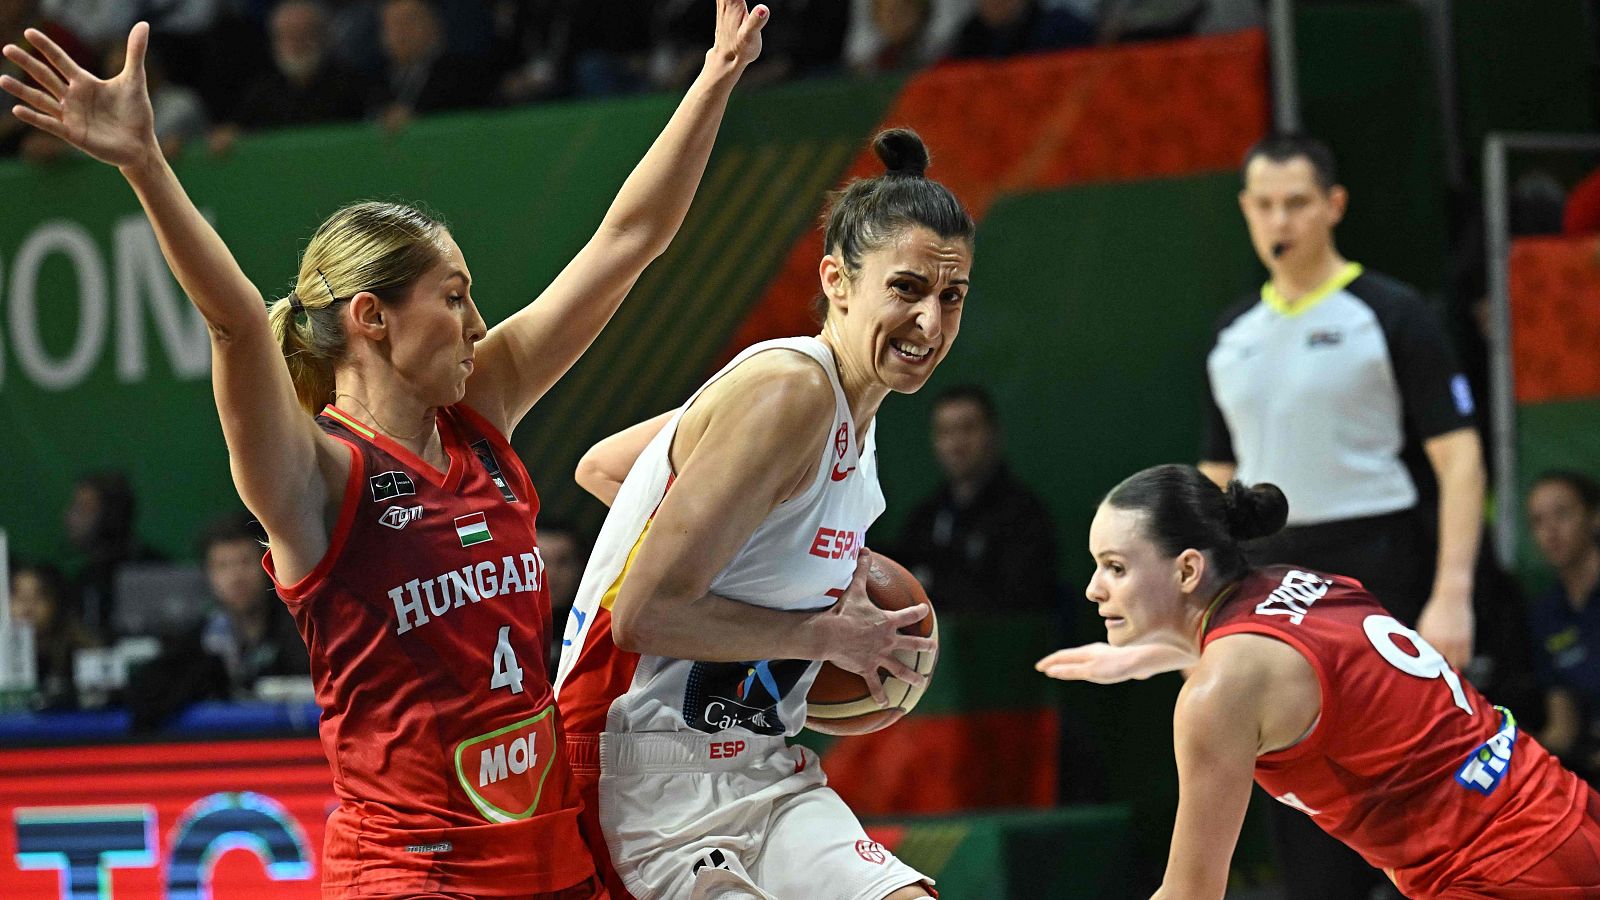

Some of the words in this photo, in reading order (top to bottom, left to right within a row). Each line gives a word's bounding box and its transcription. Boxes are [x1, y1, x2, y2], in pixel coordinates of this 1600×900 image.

[0, 211, 215, 391] ON
[490, 625, 524, 695] 4
[1363, 614, 1473, 716] 9
[479, 731, 538, 788] MOL
[709, 740, 746, 760] ESP
